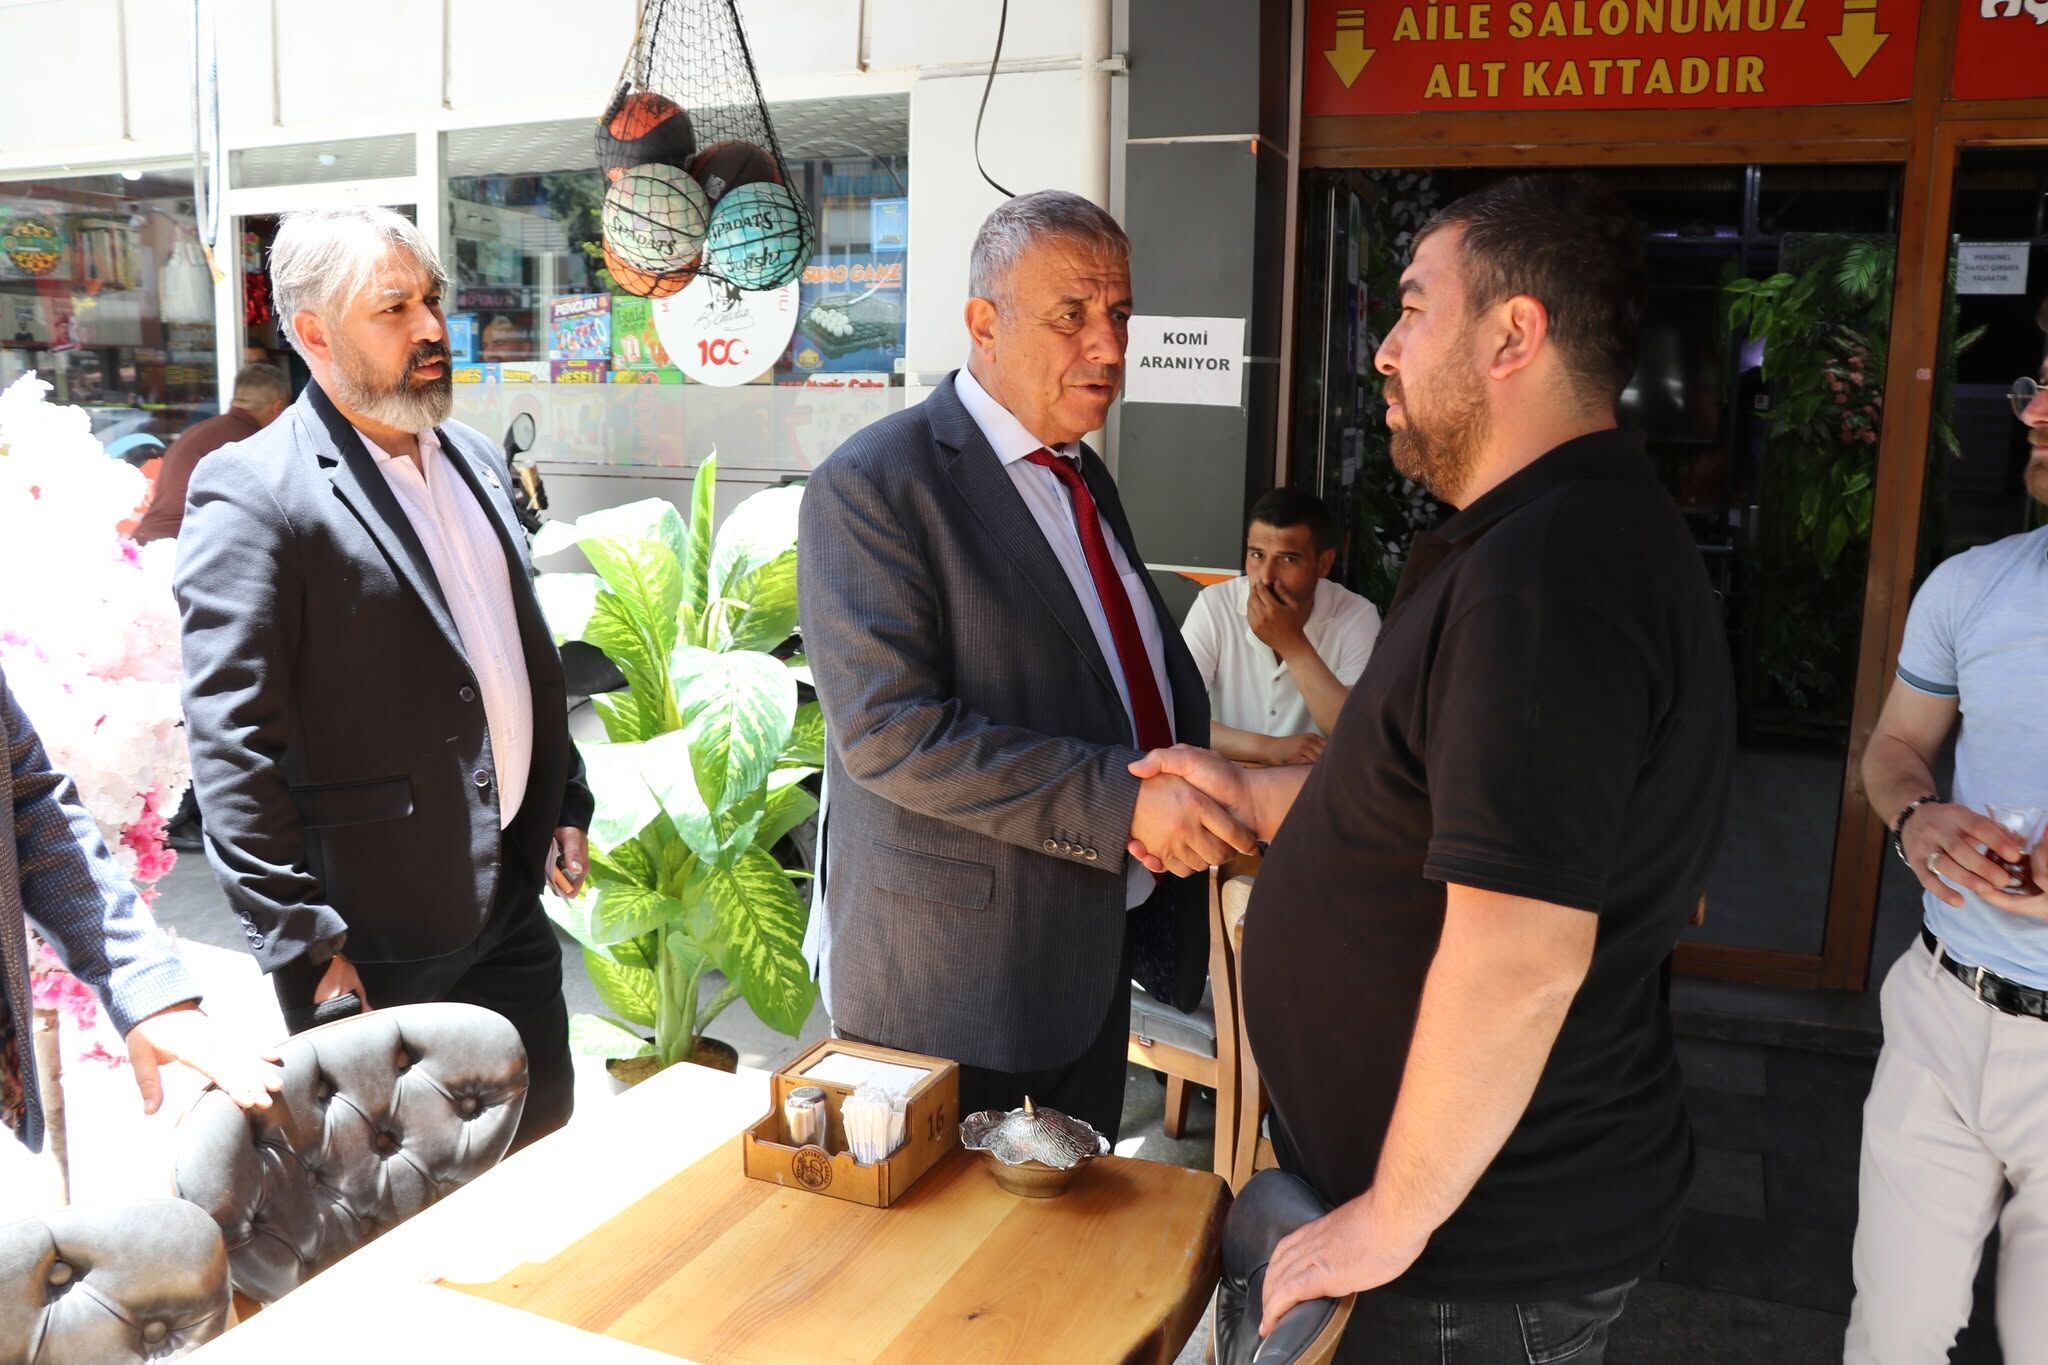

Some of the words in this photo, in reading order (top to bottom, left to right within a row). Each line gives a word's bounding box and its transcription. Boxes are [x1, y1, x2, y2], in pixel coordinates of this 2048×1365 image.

[1392, 0, 1491, 41] AİLE
[1508, 0, 1806, 38] SALONUMUZ
[1423, 62, 1506, 98] ALT
[1522, 56, 1765, 97] KATTADIR
[554, 297, 598, 316] PENGUIN
[1163, 330, 1208, 346] KOMİ
[1139, 355, 1231, 371] ARANIYOR
